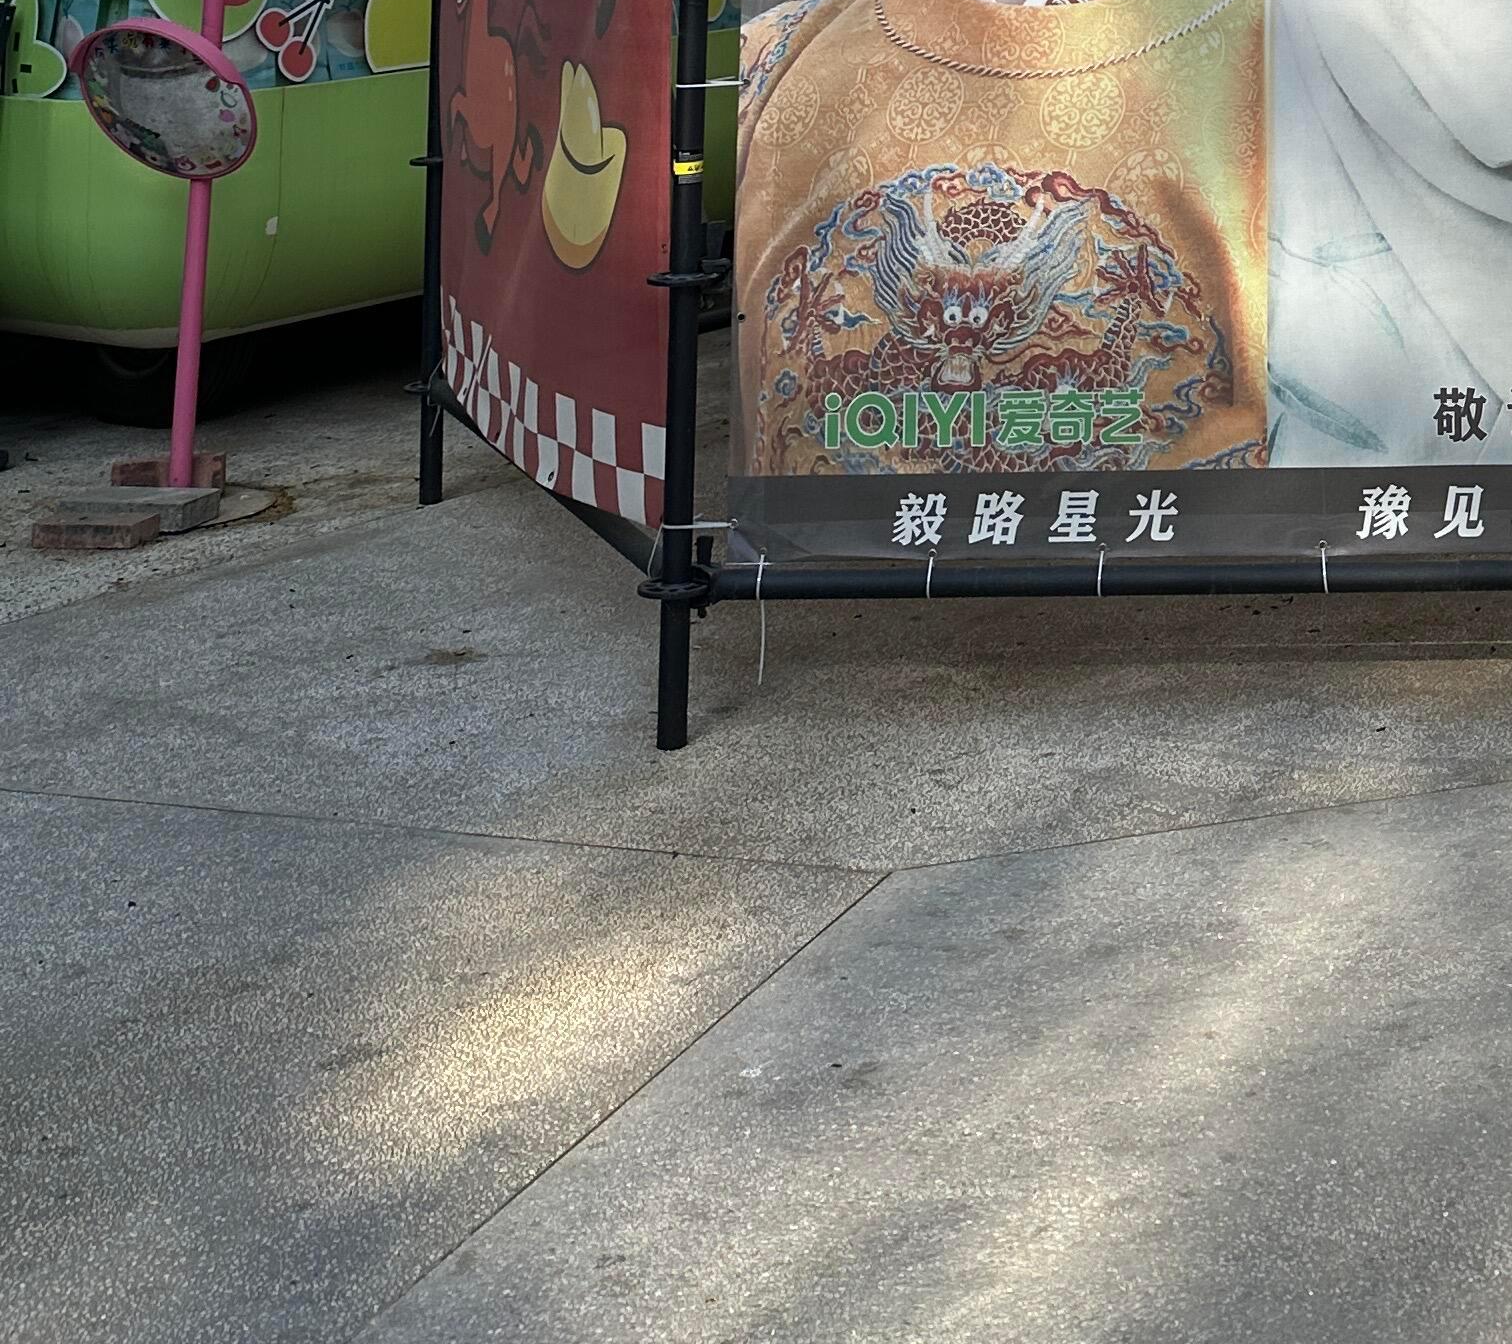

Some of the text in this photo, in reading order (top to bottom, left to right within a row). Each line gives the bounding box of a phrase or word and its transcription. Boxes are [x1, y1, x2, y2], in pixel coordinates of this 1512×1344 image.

[996, 388, 1146, 449] 爱奇艺
[891, 488, 1181, 548] 毅路星光
